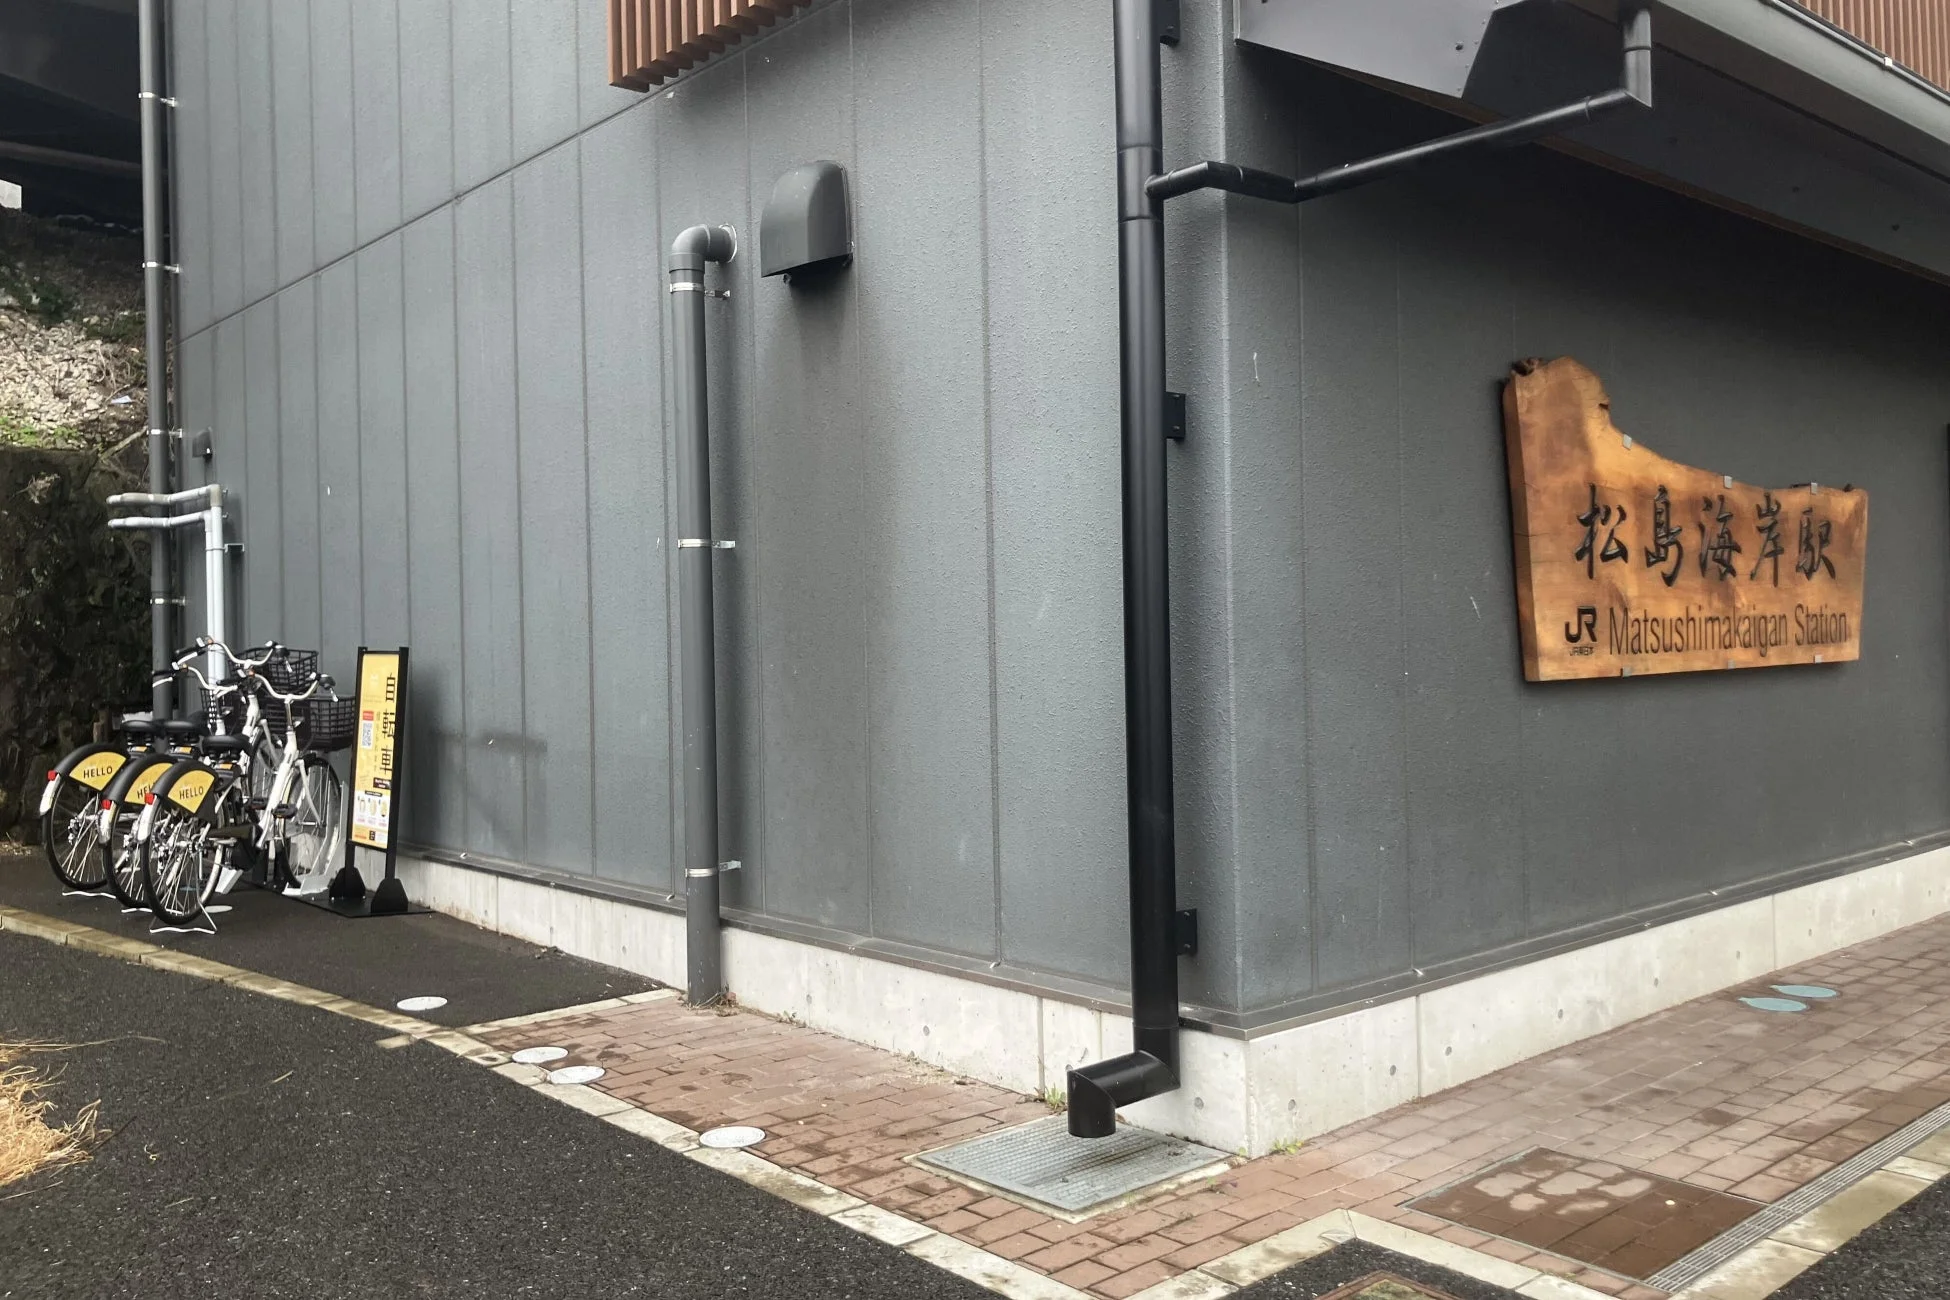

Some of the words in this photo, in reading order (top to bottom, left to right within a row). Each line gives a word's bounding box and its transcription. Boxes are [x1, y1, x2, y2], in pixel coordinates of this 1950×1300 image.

[1575, 482, 1836, 588] 松島海岸駅
[1564, 605, 1598, 642] JR
[1609, 604, 1788, 657] Matsushimakaigan
[1794, 603, 1848, 647] Station
[83, 766, 113, 779] HELLO
[179, 786, 204, 800] HELLO
